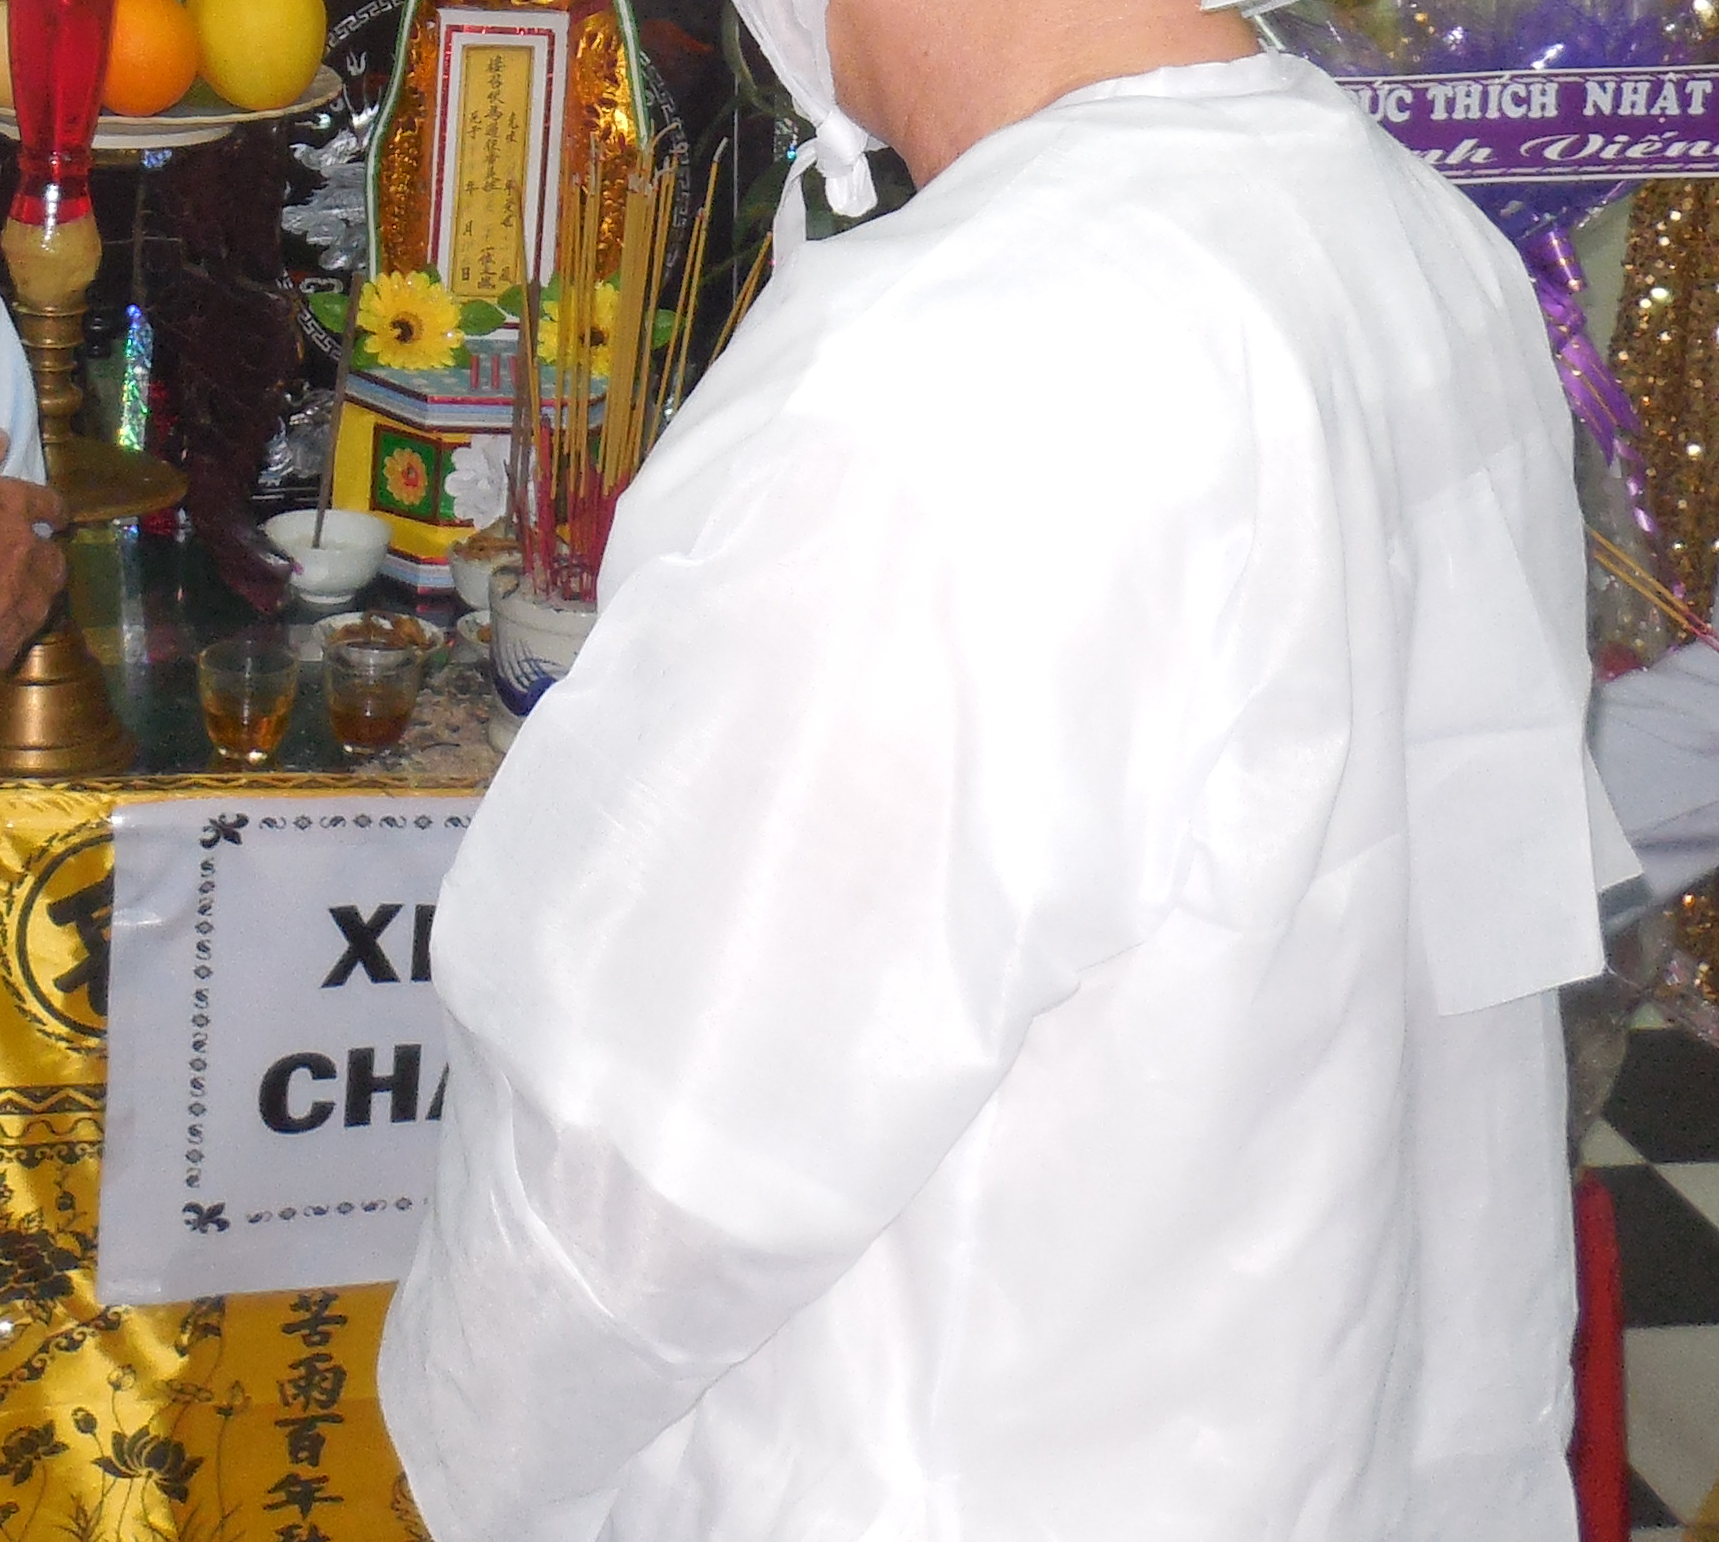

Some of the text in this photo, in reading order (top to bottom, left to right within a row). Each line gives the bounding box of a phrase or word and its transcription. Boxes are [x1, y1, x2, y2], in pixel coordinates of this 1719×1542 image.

[1426, 73, 1560, 122] THÍCH
[1582, 71, 1714, 125] NHẬT
[1519, 130, 1719, 162] Viến
[258, 1044, 450, 1135] CH
